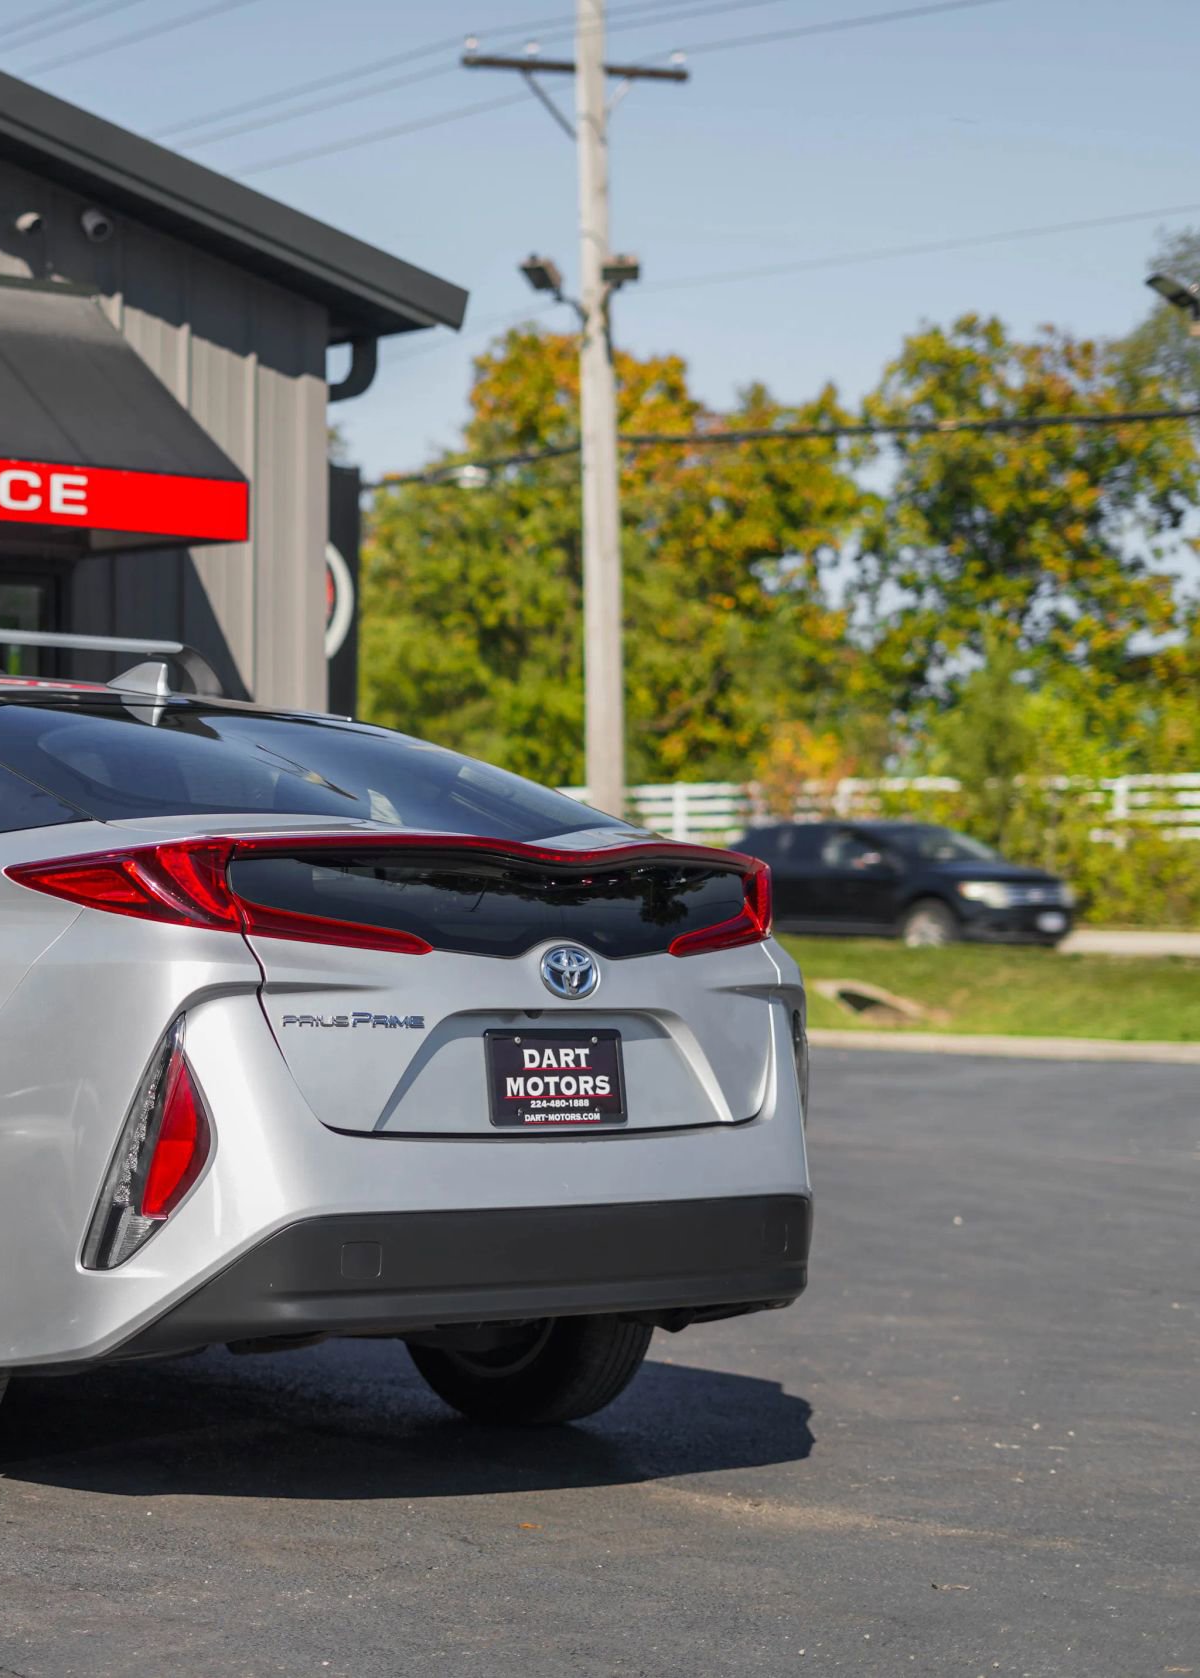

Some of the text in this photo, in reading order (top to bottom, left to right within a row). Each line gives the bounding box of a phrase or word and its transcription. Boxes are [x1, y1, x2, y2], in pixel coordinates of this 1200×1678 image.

[282, 1014, 349, 1028] PRIUS
[522, 1047, 590, 1069] DART
[505, 1075, 611, 1097] MOTORS
[530, 1099, 590, 1108] 224-480-1888
[524, 1112, 601, 1122] DART-MOTORS.COM
